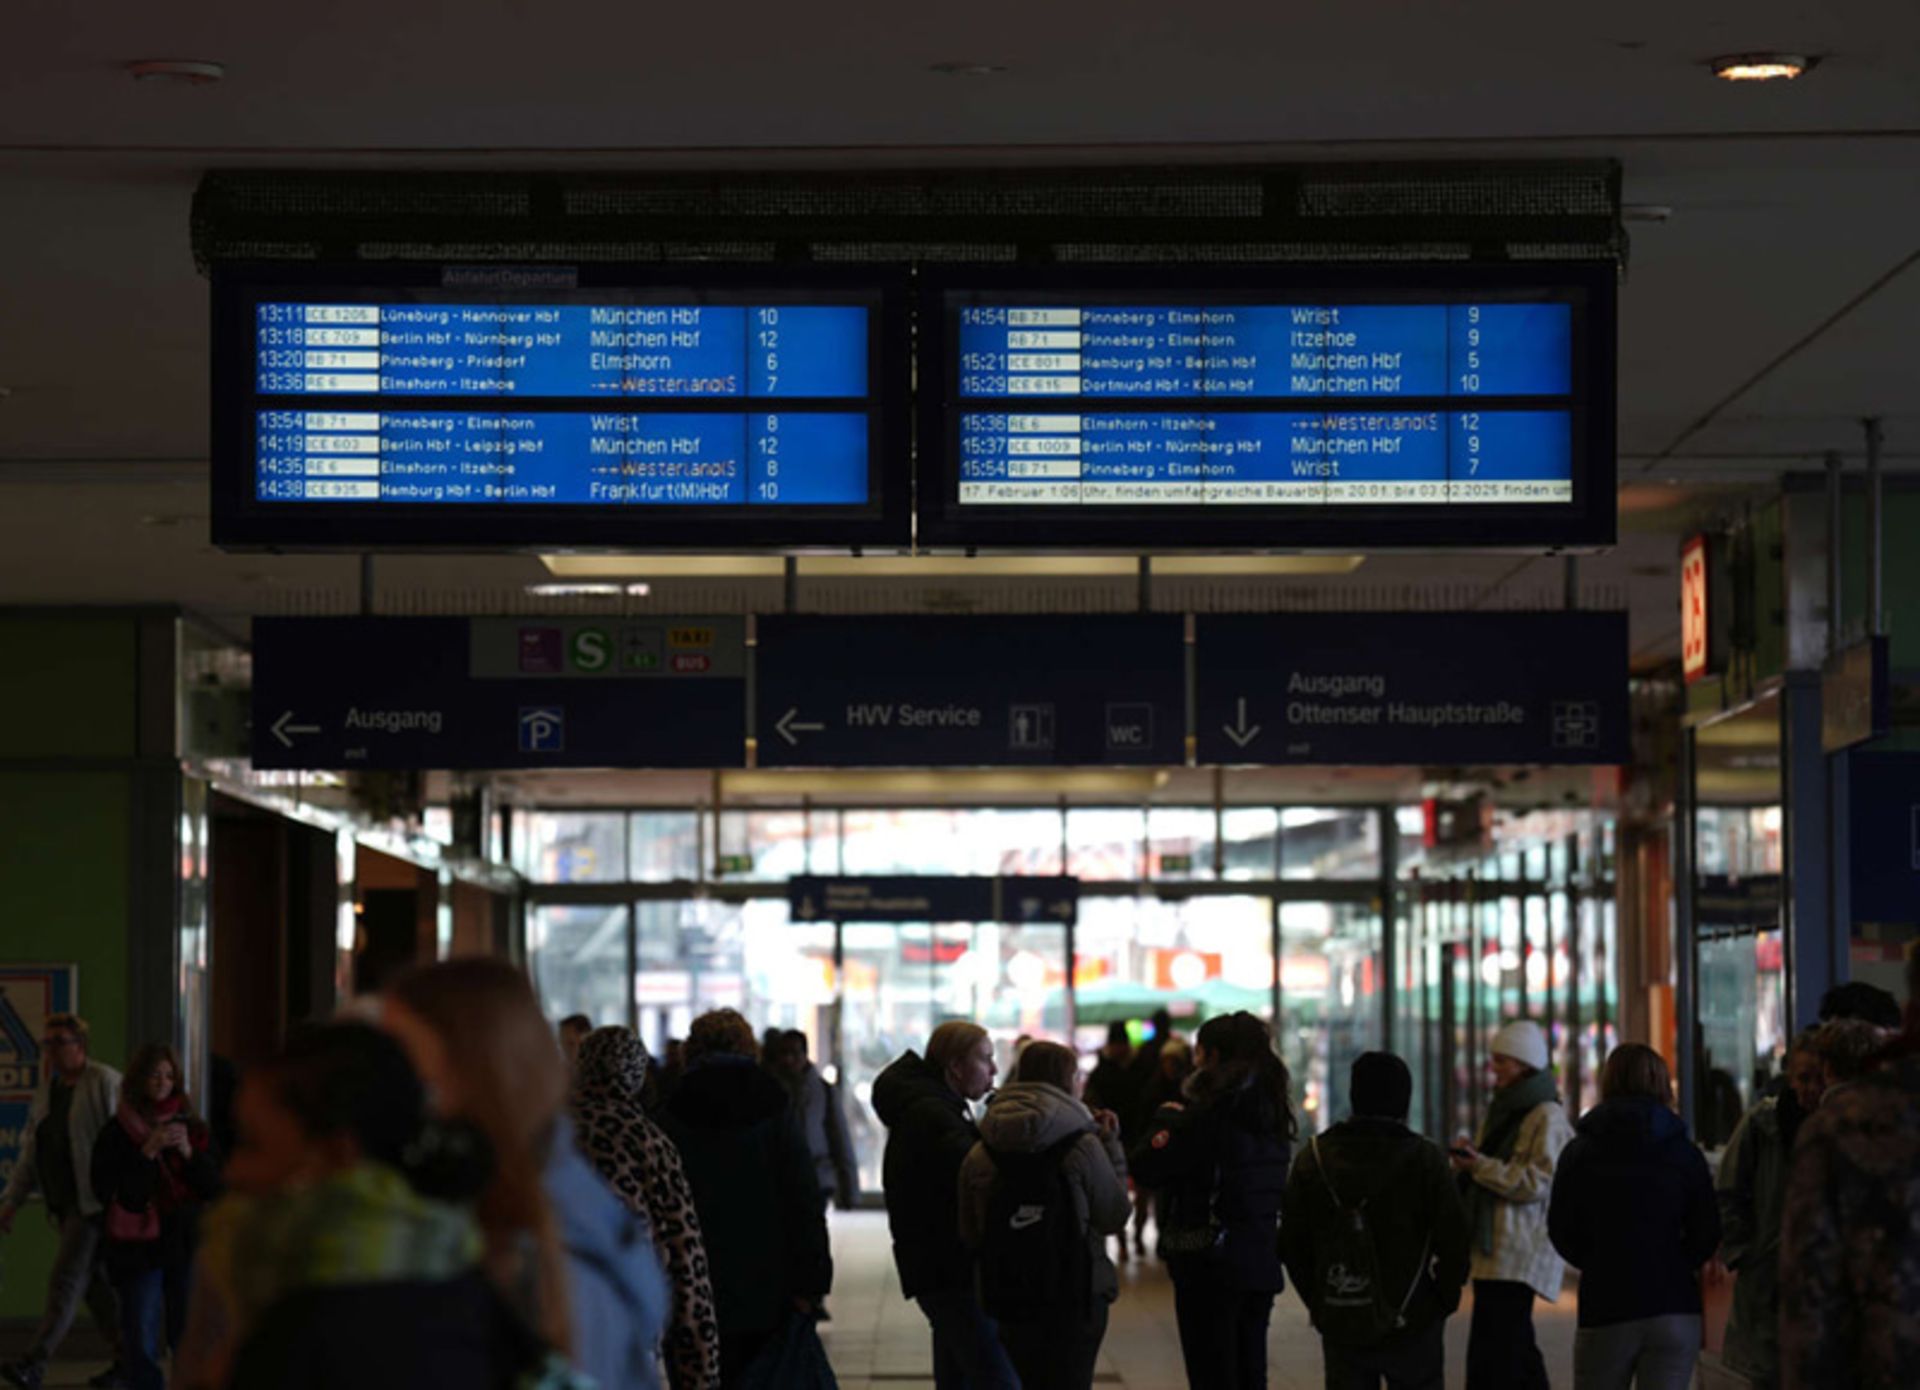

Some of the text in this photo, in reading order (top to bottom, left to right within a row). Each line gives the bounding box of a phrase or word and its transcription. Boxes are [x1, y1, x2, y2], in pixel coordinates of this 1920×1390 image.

[306, 308, 329, 320] ICE
[381, 311, 449, 324] Lüneburg
[462, 312, 531, 322] Hannover
[535, 311, 559, 322] Hbf
[591, 308, 667, 325] München
[672, 309, 700, 325] Hbf
[759, 308, 778, 325] 10
[1010, 312, 1027, 323] RB
[1032, 312, 1049, 323] 71
[1082, 312, 1155, 326] Pinneberg
[1291, 309, 1339, 324] Wrist
[1469, 307, 1479, 323] 9
[306, 330, 329, 343] ICE
[381, 332, 423, 344] Berlin
[427, 333, 451, 344] Hbf
[465, 333, 533, 348] Nürnberg
[537, 333, 561, 345] Hbf
[591, 331, 667, 347] München
[671, 331, 700, 347] Hbf
[760, 331, 777, 348] 12
[1010, 335, 1027, 346] RB
[1032, 335, 1049, 346] 71
[1082, 334, 1155, 348] Pinneberg
[1291, 332, 1356, 347] Itzehoe
[1468, 329, 1479, 346] 9
[307, 354, 324, 366] RB
[330, 354, 347, 366] 71
[381, 355, 454, 369] Pinneberg
[591, 353, 671, 370] Elmshorn
[767, 353, 778, 370] 6
[1010, 358, 1030, 368] ICE
[1082, 358, 1144, 371] Hamburg
[1148, 357, 1172, 368] Hbf
[1185, 356, 1228, 368] Berlin
[1232, 356, 1256, 368] Hbf
[1291, 353, 1368, 370] München
[1372, 353, 1401, 369] Hbf
[1468, 351, 1479, 368] 5
[307, 376, 324, 388] RE
[328, 376, 338, 388] 6
[461, 379, 515, 390] Itzehoe
[768, 376, 777, 391] 7
[1010, 380, 1030, 391] ICE
[1082, 379, 1152, 391] Dortmund
[1155, 379, 1179, 391] Hbf
[1193, 380, 1226, 391] Köln
[1229, 379, 1254, 391] Hbf
[1291, 376, 1368, 392] München
[1372, 375, 1401, 392] Hbf
[1461, 374, 1479, 391] 10
[307, 416, 324, 428] RB
[330, 416, 347, 428] 71
[381, 417, 454, 431] Pinneberg
[591, 416, 638, 431] Wrist
[767, 415, 778, 432] 8
[1010, 418, 1027, 429] RE
[1031, 418, 1040, 429] 6
[1161, 419, 1215, 430] Itzehoe
[1461, 413, 1479, 430] 12
[306, 438, 329, 450] ICE
[381, 439, 423, 451] Berlin
[427, 439, 451, 451] Hbf
[465, 441, 515, 454] Leipzig
[519, 440, 543, 452] Hbf
[591, 438, 667, 454] München
[672, 438, 700, 454] Hbf
[759, 437, 777, 454] 12
[1010, 440, 1030, 452] ICE
[1037, 440, 1070, 452] 1009
[1082, 440, 1124, 452] Berlin
[1128, 441, 1152, 452] Hbf
[1166, 441, 1234, 454] Nürnberg
[1237, 440, 1261, 452] Hbf
[1292, 437, 1368, 454] München
[1372, 437, 1401, 453] Hbf
[1468, 436, 1479, 453] 9
[307, 461, 324, 472] RE
[328, 461, 338, 472] 6
[461, 463, 515, 474] Itzehoe
[767, 460, 778, 477] 8
[1010, 464, 1027, 474] RB
[1032, 464, 1049, 474] 71
[1082, 463, 1155, 477] Pinneberg
[1291, 461, 1339, 475] Wrist
[1469, 458, 1479, 474] 7
[306, 483, 329, 496] ICE
[381, 485, 443, 499] Hamburg
[447, 485, 471, 497] Hbf
[485, 485, 528, 496] Berlin
[531, 486, 555, 497] Hbf
[759, 482, 778, 499] 10
[988, 485, 1045, 498] Februar
[670, 629, 710, 646] TAXI
[674, 656, 706, 669] BUS
[1288, 672, 1386, 698] Ausgang
[344, 706, 443, 734] Ausgang
[847, 704, 981, 726] HVV Service
[1288, 702, 1525, 728] Ottenser Hauptstraße
[1111, 725, 1142, 743] WC
